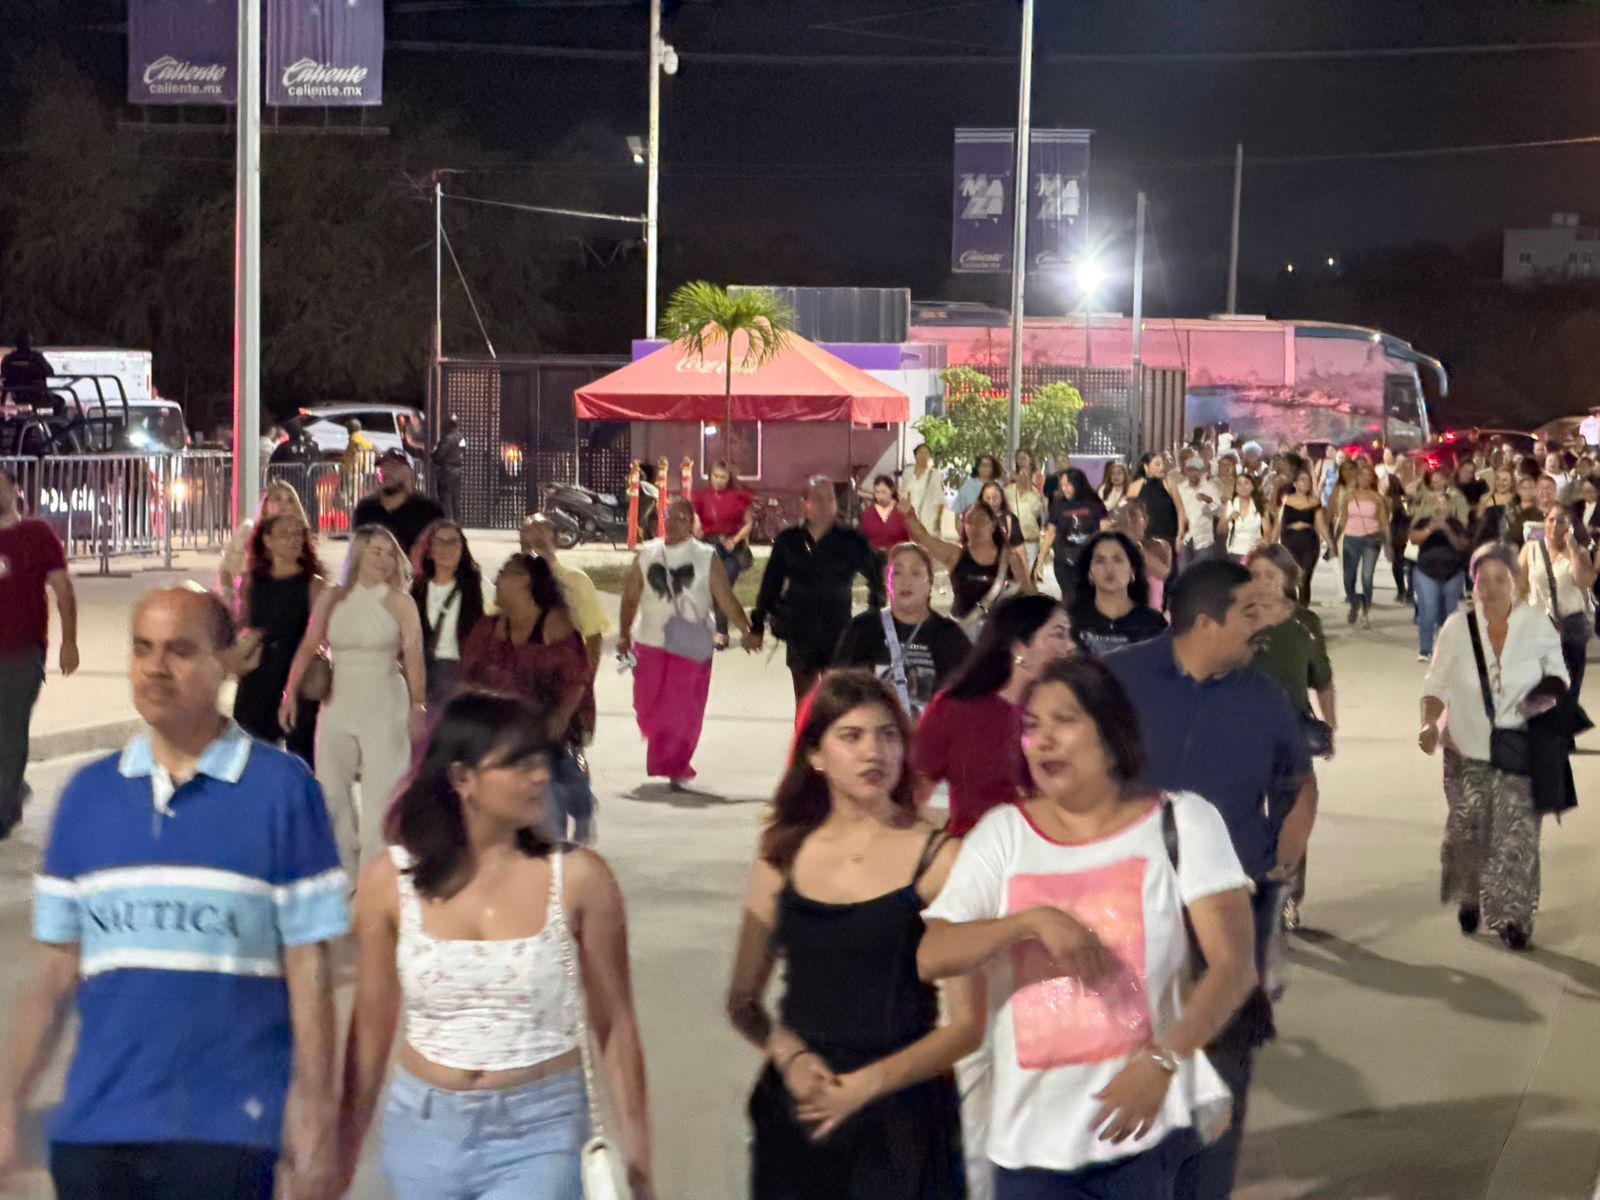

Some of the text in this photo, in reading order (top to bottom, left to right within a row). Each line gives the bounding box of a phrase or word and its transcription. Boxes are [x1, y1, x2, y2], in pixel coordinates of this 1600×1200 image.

[143, 55, 227, 84] Caliente
[282, 57, 368, 87] Caliente
[149, 82, 222, 95] caliente.mx
[288, 85, 362, 97] caliente.mx
